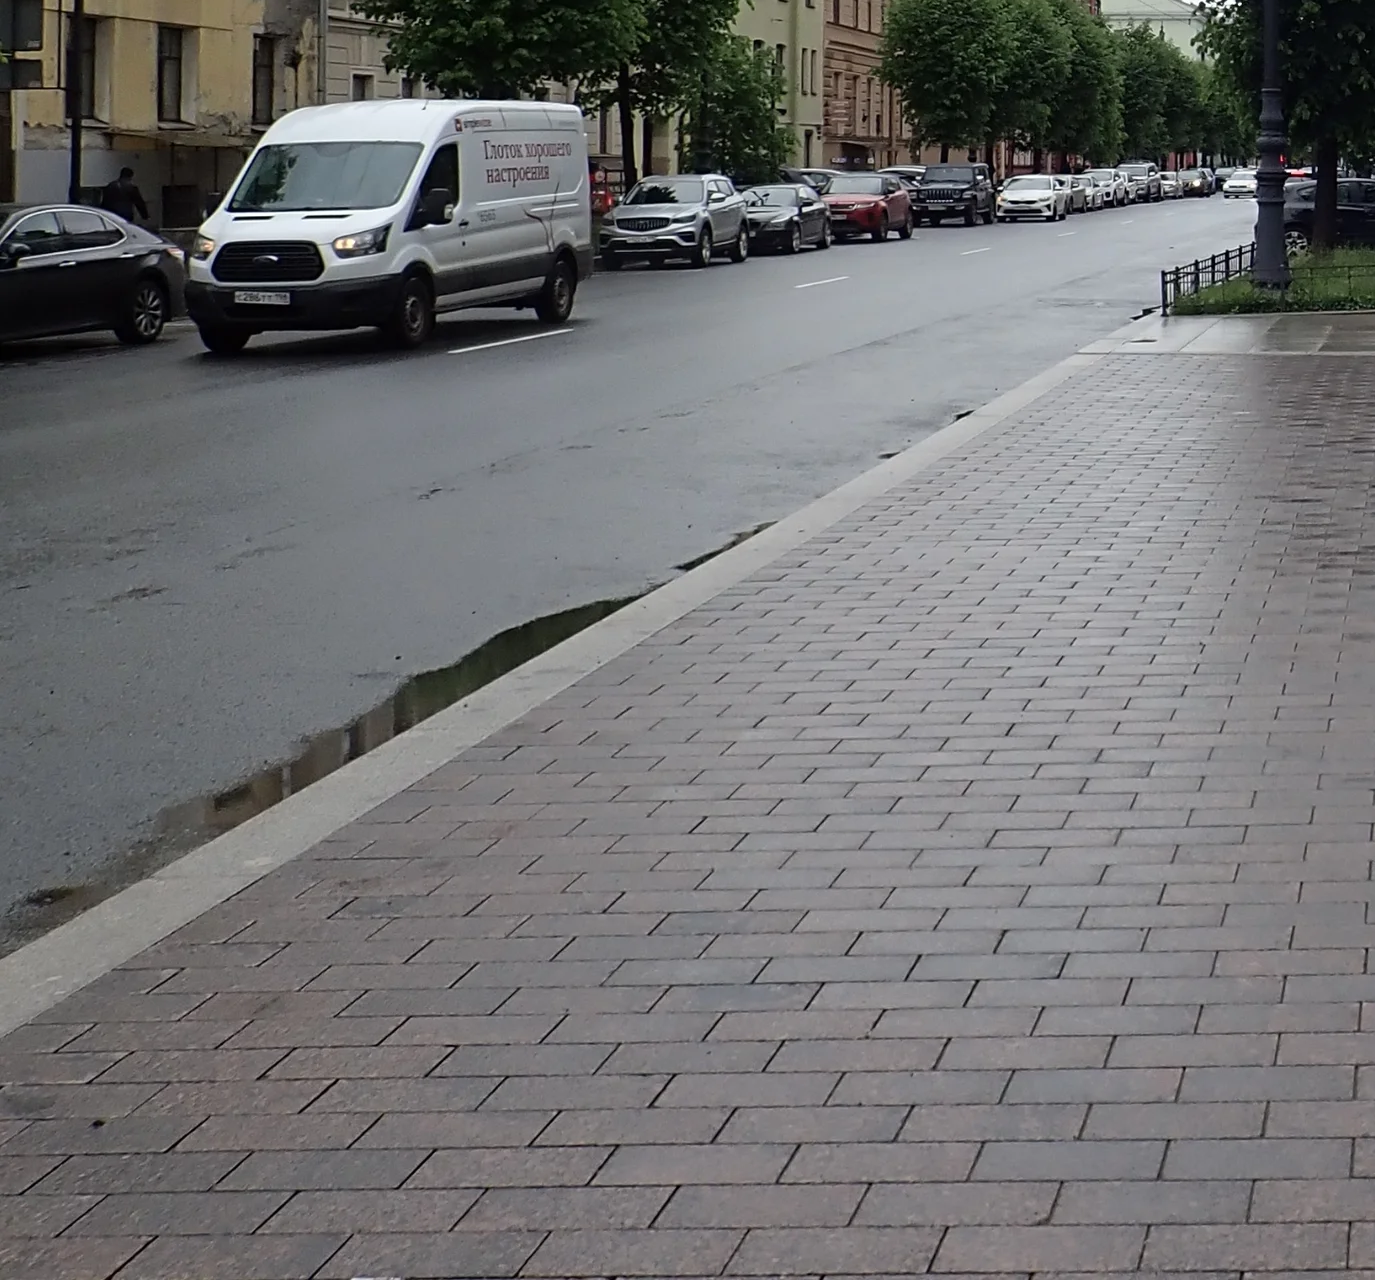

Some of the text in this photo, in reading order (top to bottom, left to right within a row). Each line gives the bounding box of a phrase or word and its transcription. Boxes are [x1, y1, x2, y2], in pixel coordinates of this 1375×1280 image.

[483, 140, 572, 163] Глоток хорошего
[486, 166, 549, 188] настроения
